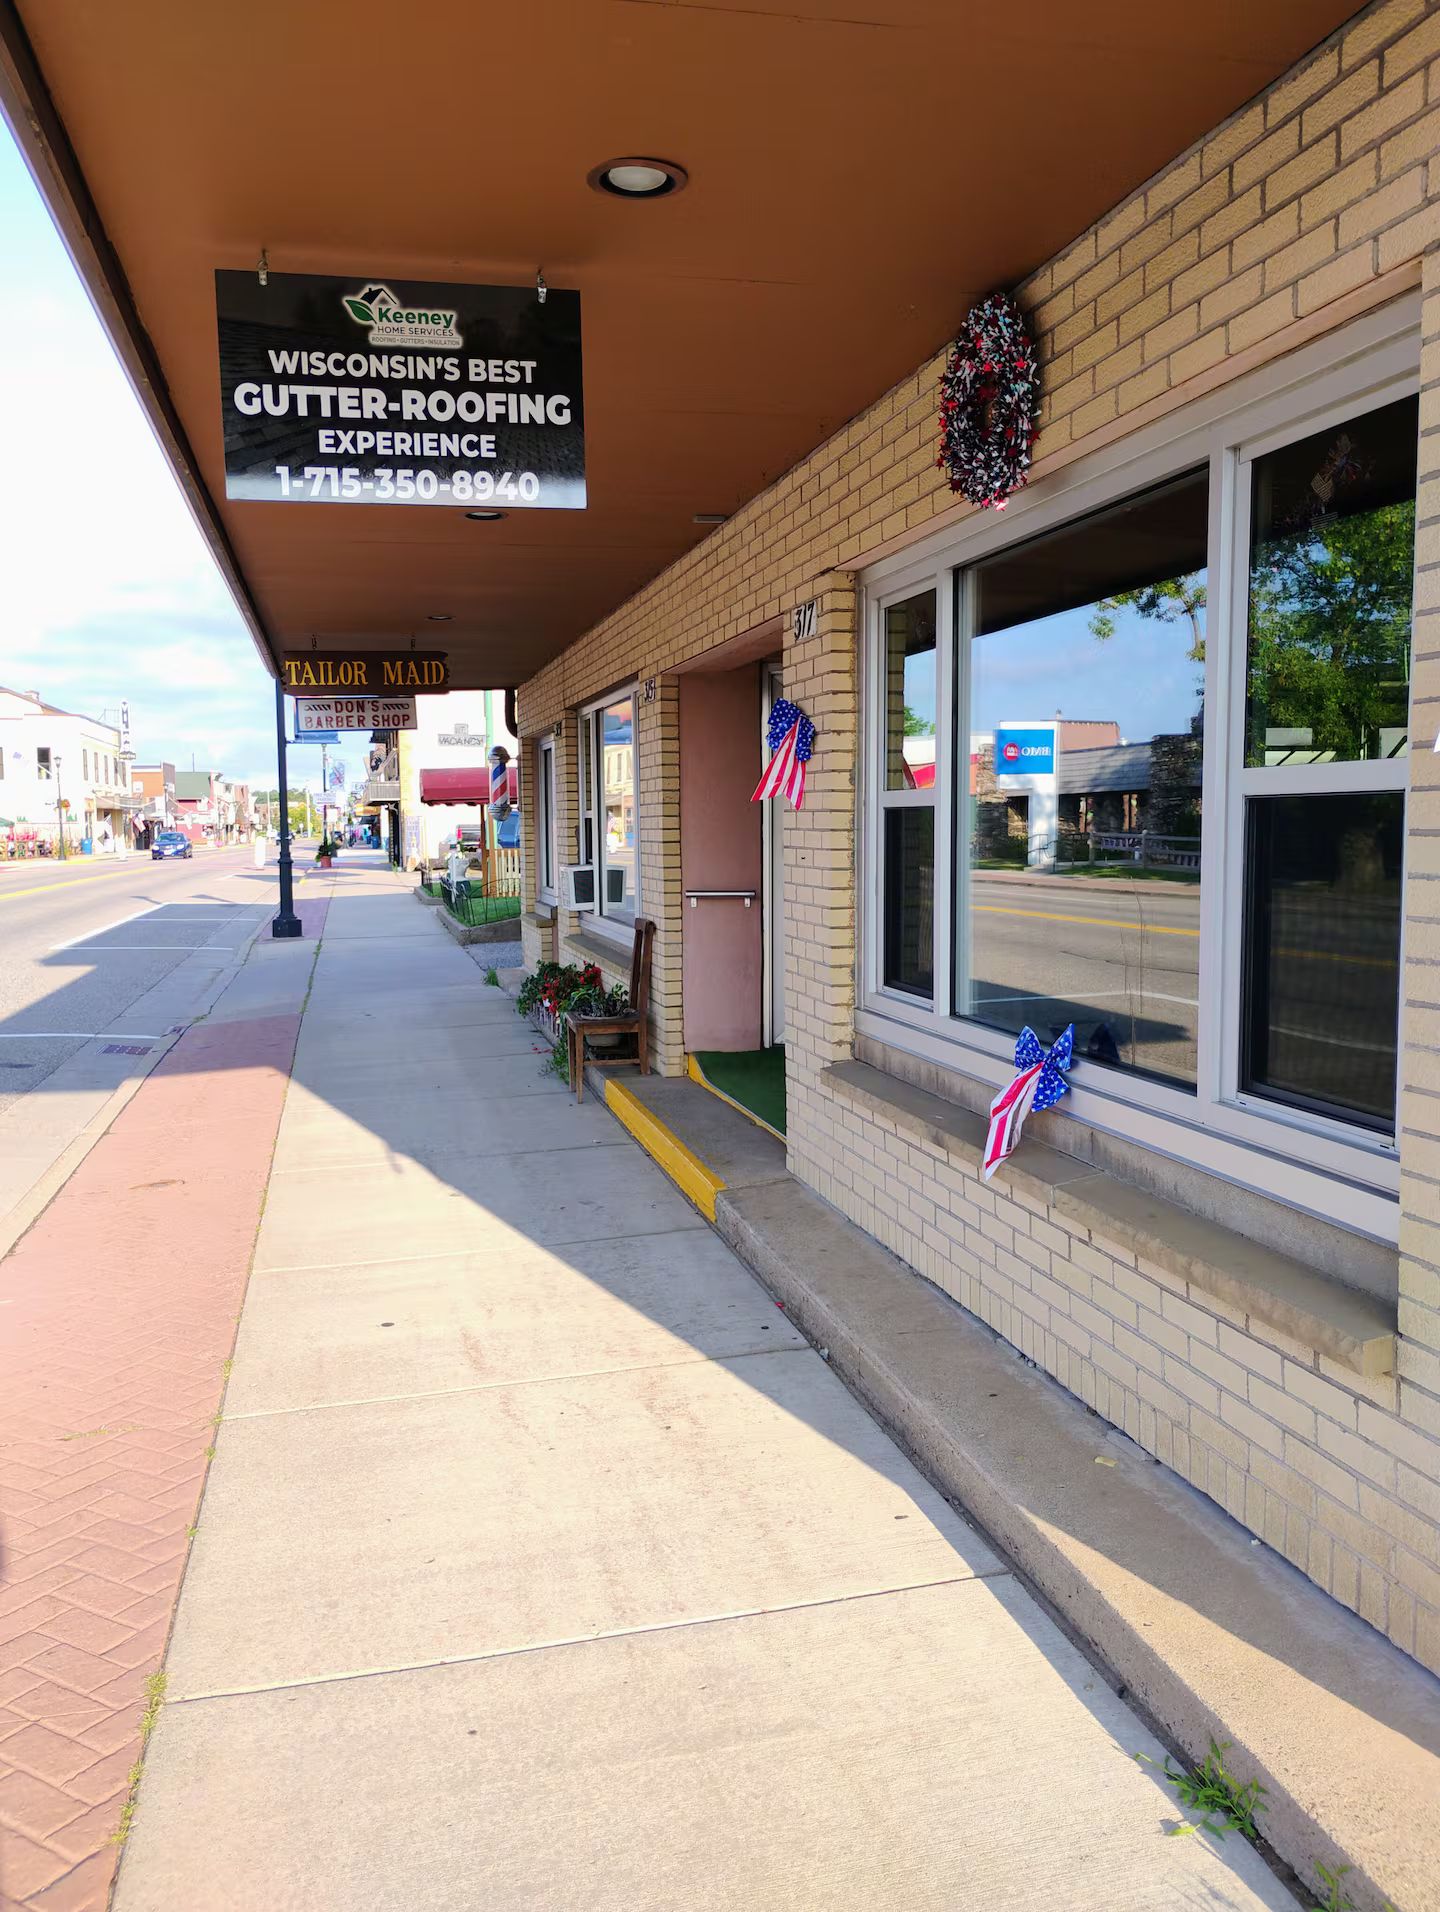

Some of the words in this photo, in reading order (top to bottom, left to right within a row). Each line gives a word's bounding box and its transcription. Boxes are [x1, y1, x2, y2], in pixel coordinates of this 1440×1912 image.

[378, 307, 454, 328] Keeney
[377, 326, 406, 336] HOME
[408, 328, 454, 337] SERVICES
[268, 350, 460, 381] WISCONSIN'S
[468, 359, 537, 383] BEST
[233, 382, 572, 425] GUTTER-ROOFING
[318, 429, 497, 458] EXPERIENCE
[275, 465, 540, 501] 1-715-350-8940
[794, 601, 815, 641] 317
[285, 660, 368, 686] TAILOR
[382, 661, 445, 686] MAID
[335, 700, 380, 713] DON'S
[305, 715, 366, 729] BARBER
[371, 713, 410, 727] SHOP
